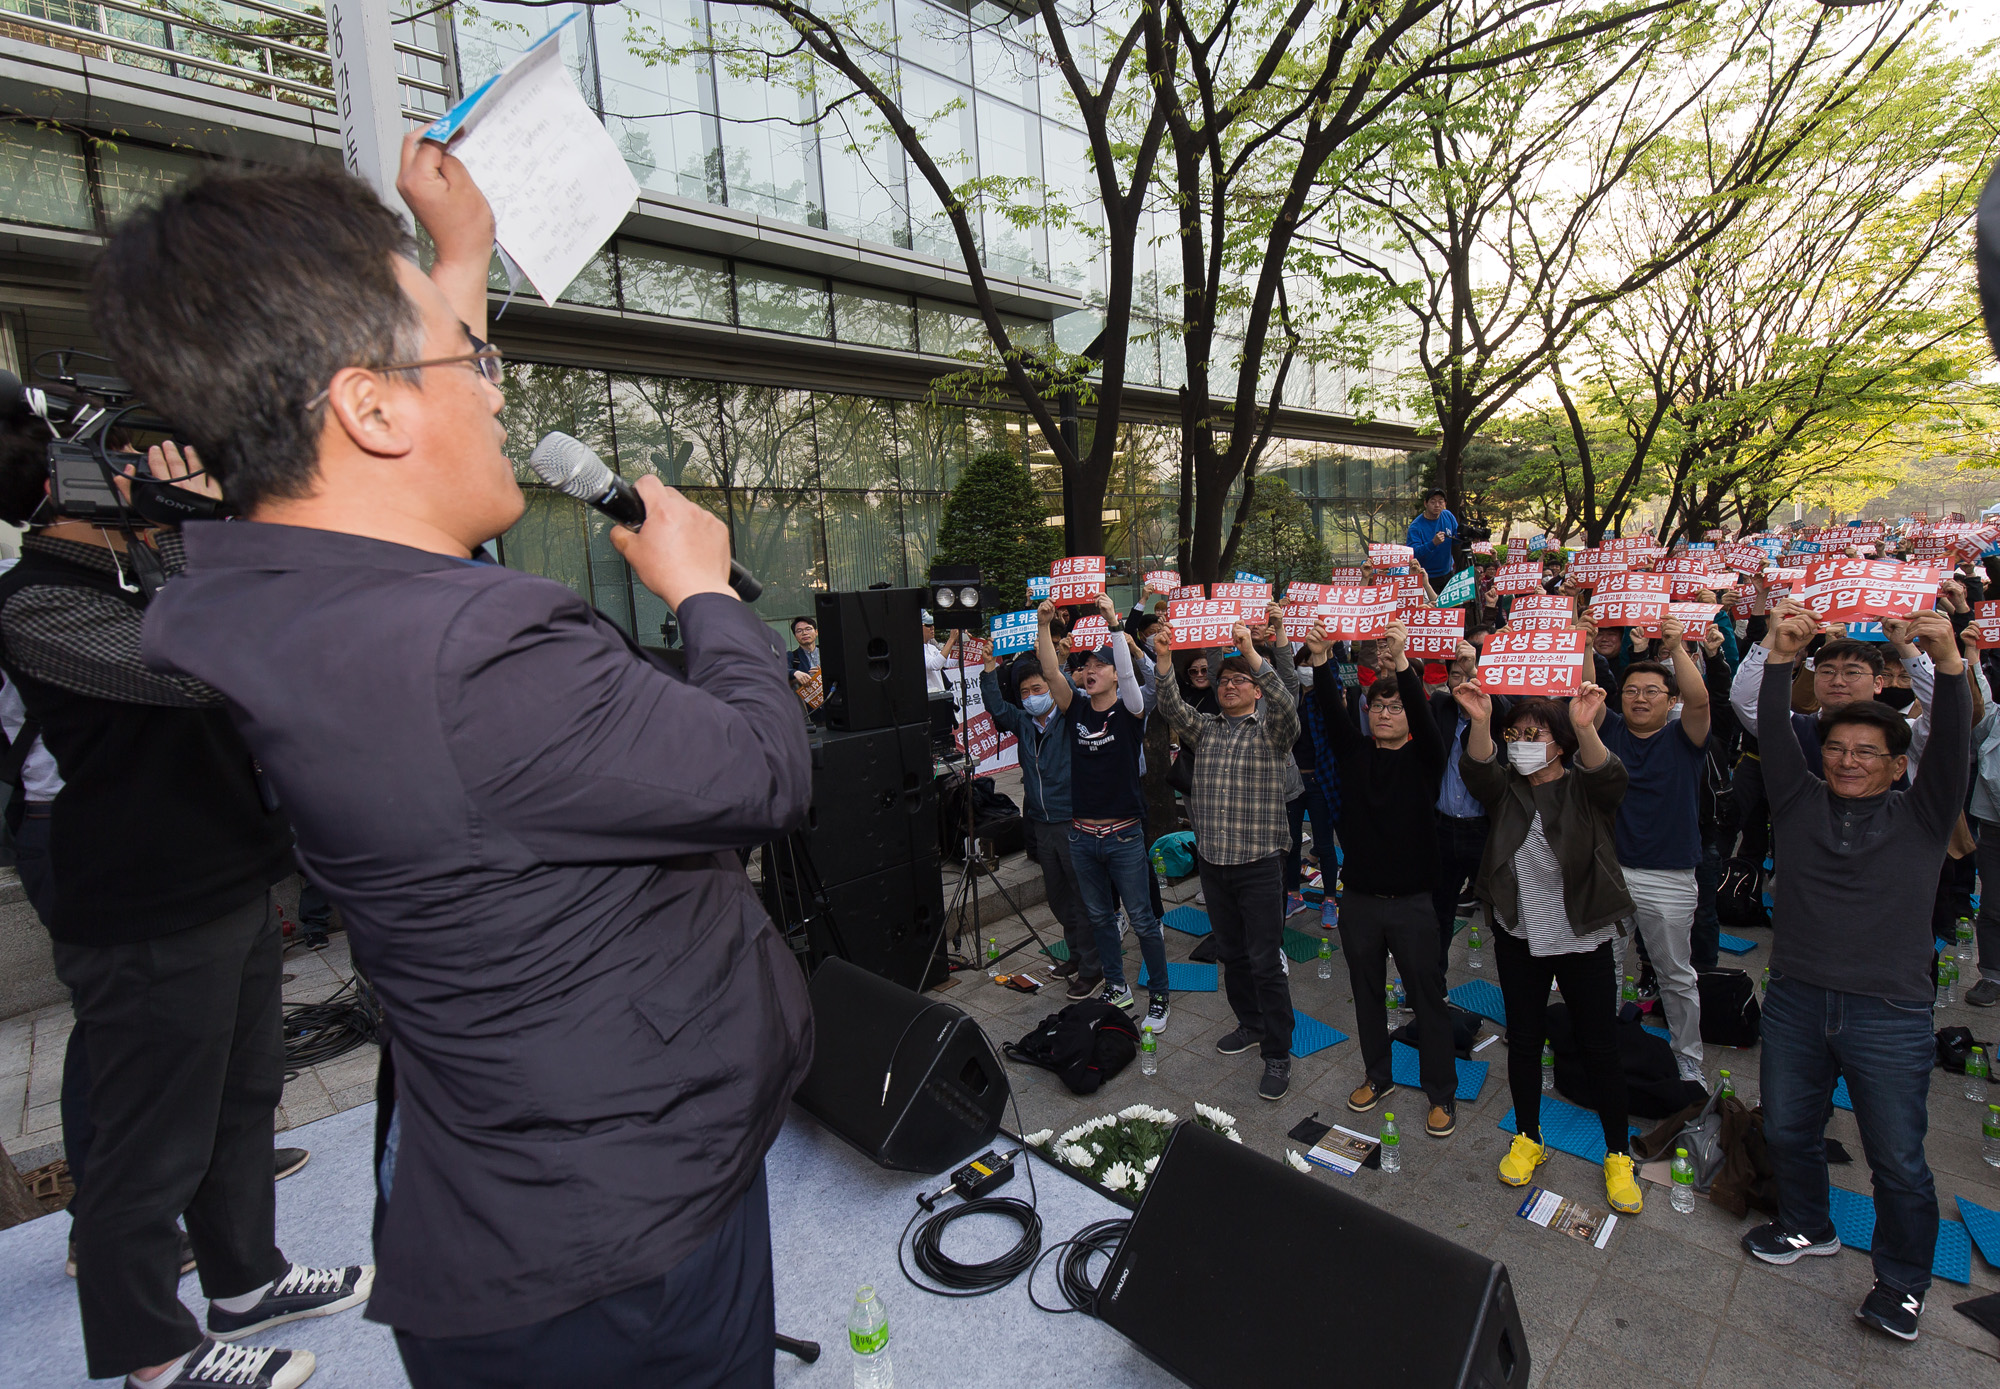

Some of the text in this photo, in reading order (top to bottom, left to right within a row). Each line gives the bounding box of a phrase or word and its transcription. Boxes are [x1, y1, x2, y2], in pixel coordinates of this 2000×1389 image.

[154, 495, 196, 513] SONY
[1813, 530, 1849, 540] 삼성증권
[1917, 536, 1955, 548] 삼성증권
[1604, 538, 1647, 551] 삼성증권
[1373, 555, 1410, 565] 영업정지
[1578, 552, 1624, 564] 삼성증권
[1783, 554, 1825, 566] 삼성증권
[1052, 558, 1100, 576] 삼성증권
[1499, 563, 1539, 575] 삼성증권
[1655, 559, 1704, 574] 삼성증권
[1814, 560, 1929, 581] 삼성증권
[1216, 584, 1268, 598] 삼성증권
[1496, 580, 1537, 591] 영업정지
[1596, 574, 1664, 593] 삼성증권
[1820, 580, 1915, 591] 검찰고발 압수수색!
[1051, 583, 1100, 600] 영업정지
[1169, 586, 1200, 599] 삼성증권
[1326, 584, 1394, 604] 삼성증권
[1175, 601, 1236, 617] 삼성증권
[1360, 605, 1386, 613] 압수수색!
[1515, 596, 1568, 610] 삼성증권
[1811, 589, 1923, 614] 영업정지
[1400, 610, 1459, 625] 삼성증권
[1592, 603, 1662, 620] 영업정지
[994, 612, 1038, 629] 통 큰 위조
[1077, 616, 1106, 628] 삼성증
[1324, 614, 1390, 633] 영업정지
[1512, 618, 1566, 631] 영업정지
[995, 632, 1038, 650] 112조원
[1174, 624, 1233, 643] 영업정지
[1490, 632, 1578, 652] 삼성증권
[1484, 666, 1573, 686] 영업정지
[1112, 1268, 1130, 1301] TWAUDIO
